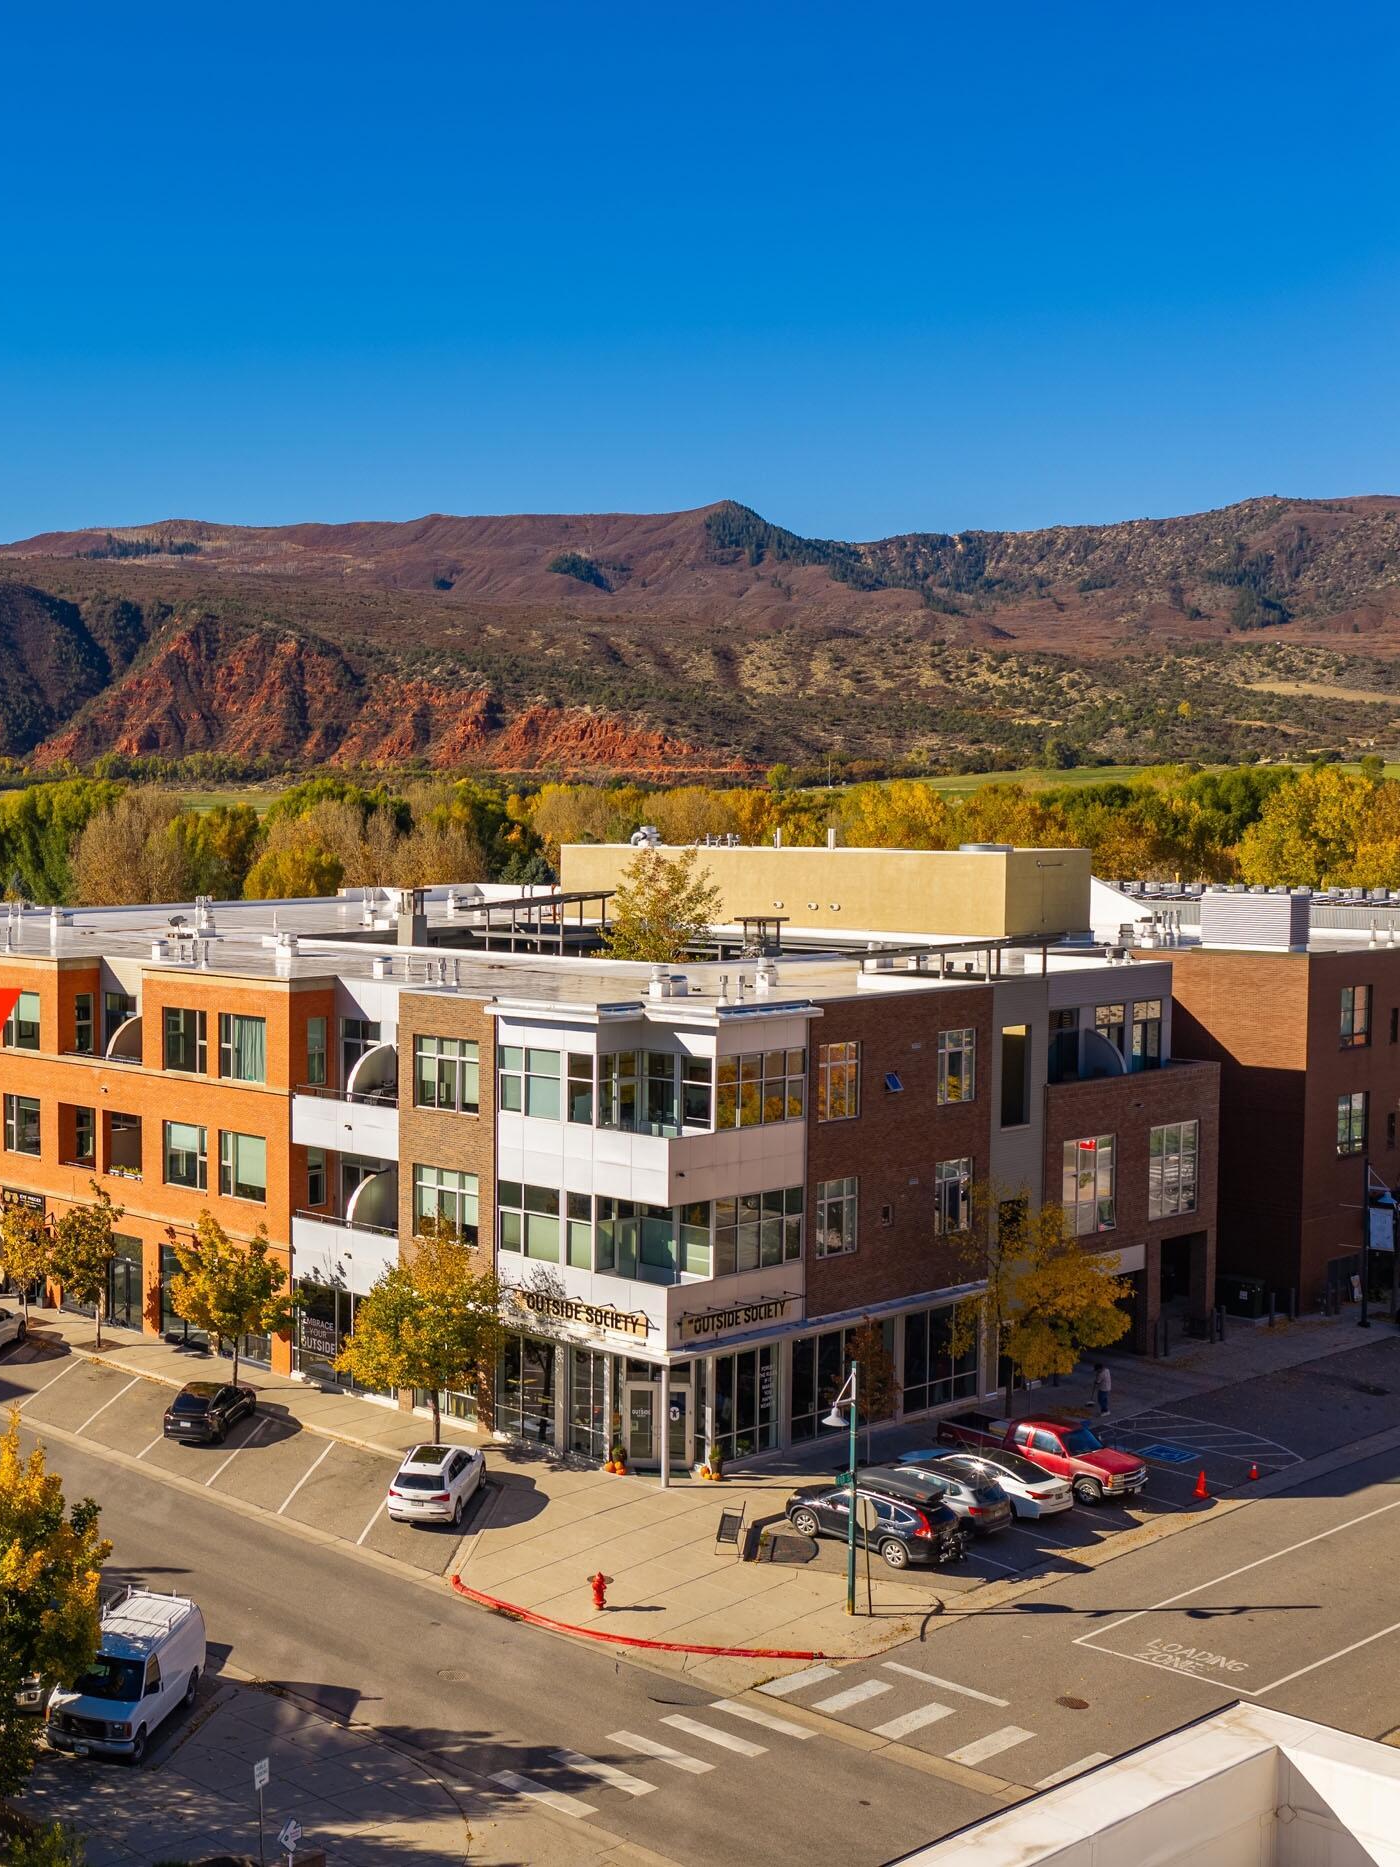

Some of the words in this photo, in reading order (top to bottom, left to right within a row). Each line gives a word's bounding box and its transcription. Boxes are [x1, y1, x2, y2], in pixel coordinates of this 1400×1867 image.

[303, 1317, 334, 1331] EMBRACE
[526, 1294, 582, 1321] OUTSIDE
[585, 1306, 640, 1334] SOCIETY
[694, 1311, 741, 1335] OUTSIDE
[744, 1300, 786, 1324] SOCIETY
[301, 1335, 336, 1355] OUTSIDE
[310, 1327, 327, 1339] YOUR
[1133, 1648, 1205, 1674] ZONE
[1145, 1638, 1249, 1672] LOADING
